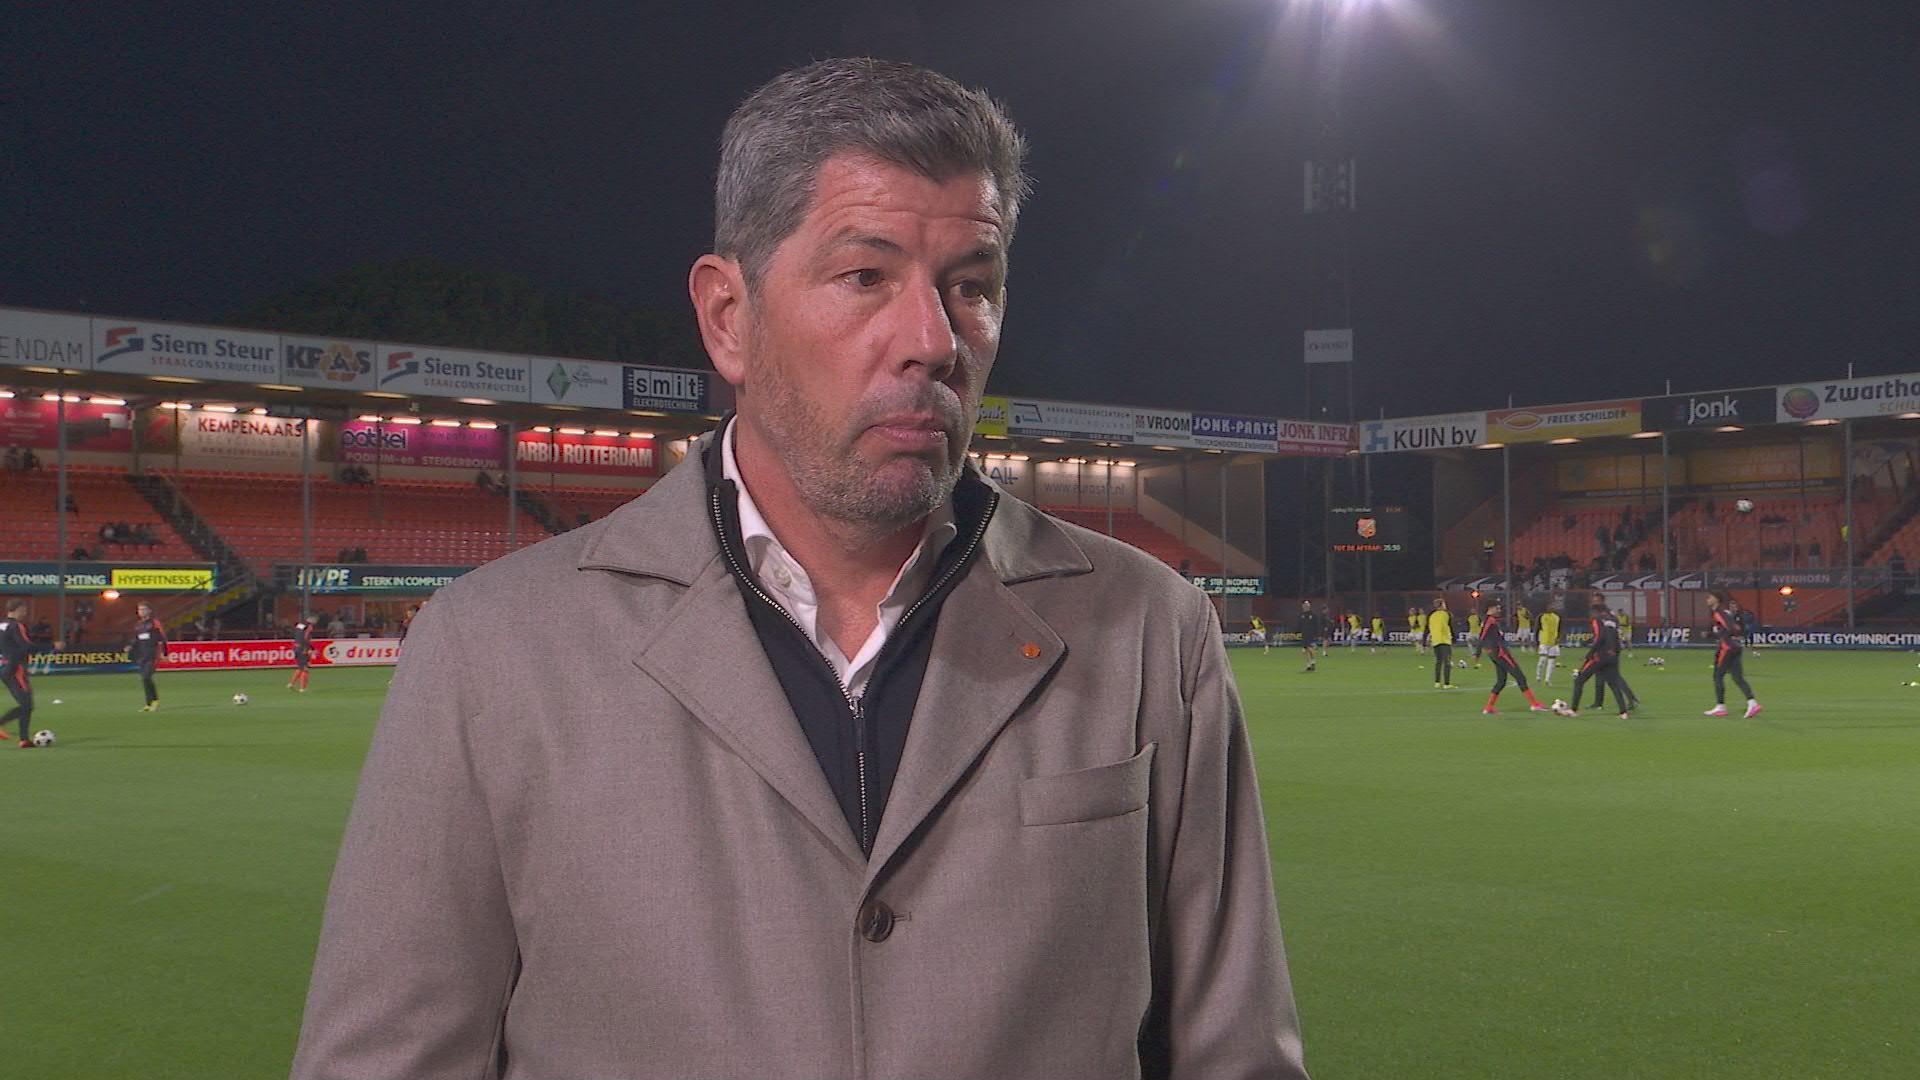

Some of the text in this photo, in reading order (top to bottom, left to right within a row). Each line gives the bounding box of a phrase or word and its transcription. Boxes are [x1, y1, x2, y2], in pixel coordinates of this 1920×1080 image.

[151, 333, 275, 361] Siem Steur
[424, 356, 526, 381] Siem Steur
[636, 378, 698, 400] smit
[1147, 414, 1191, 432] VROOM
[1193, 416, 1277, 437] JONK-PARTS
[1547, 409, 1627, 425] FREEK SCHILDER
[198, 417, 304, 438] KEMPENAARS
[1280, 422, 1315, 441] JONK
[1394, 425, 1477, 450] KUIN bv
[517, 440, 653, 469] ARBO ROTTERDAM
[118, 574, 206, 586] HYPEFITNESS.NL
[362, 576, 393, 587] STERK
[394, 576, 404, 587] IN
[1648, 628, 1691, 644] HYPE
[1753, 633, 1767, 644] IN
[1768, 633, 1832, 645] COMPLETE
[28, 651, 131, 665] HYPEFITNESS.NL
